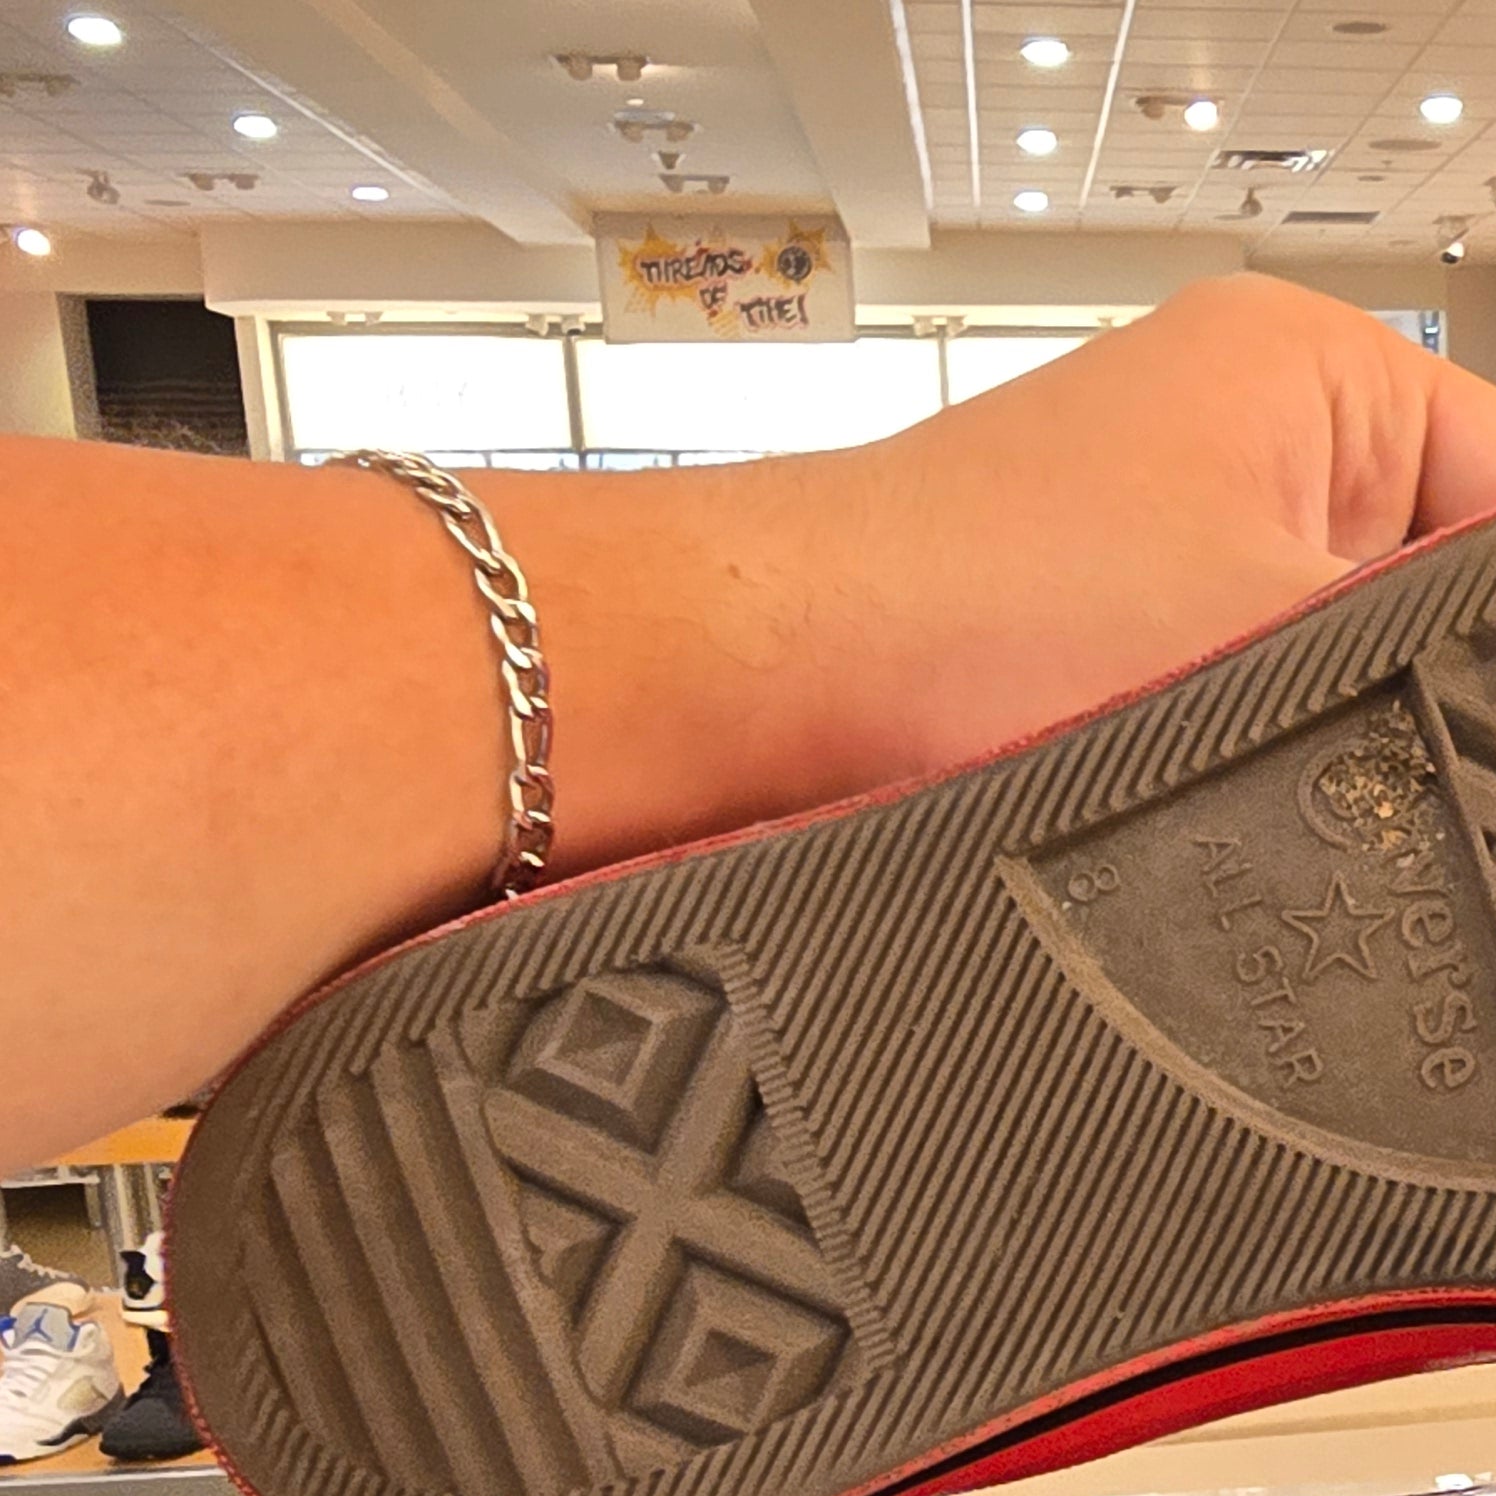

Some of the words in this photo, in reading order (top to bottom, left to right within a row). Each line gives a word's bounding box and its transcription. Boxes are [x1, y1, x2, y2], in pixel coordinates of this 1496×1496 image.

[639, 250, 745, 283] THREADS
[700, 285, 728, 309] OF
[1068, 864, 1120, 901] 8
[1193, 836, 1263, 930] ALL
[1235, 945, 1323, 1087] STAR
